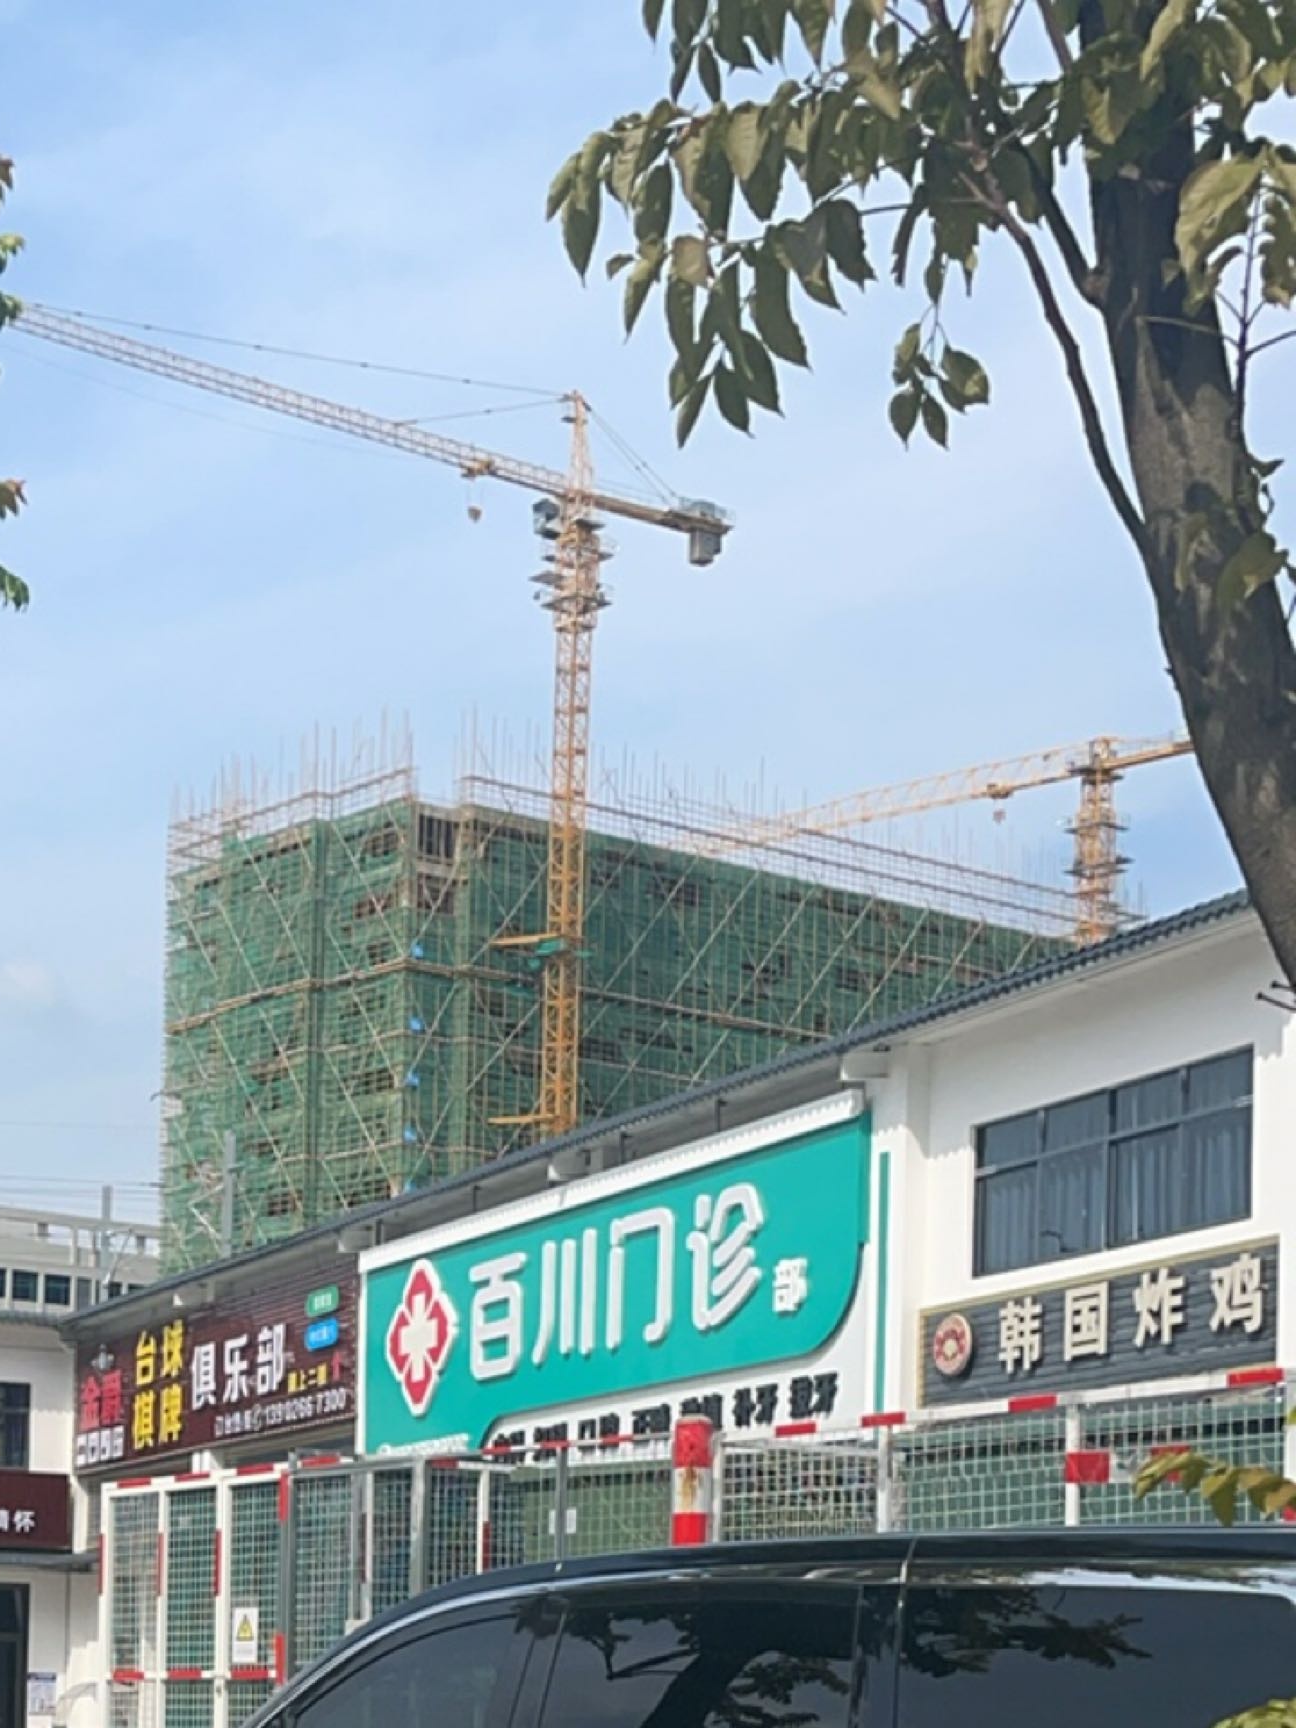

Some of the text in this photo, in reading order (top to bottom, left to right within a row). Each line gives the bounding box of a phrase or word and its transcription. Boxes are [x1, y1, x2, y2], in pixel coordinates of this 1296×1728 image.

[468, 1183, 809, 1382] 百川门诊部
[997, 1252, 1266, 1375] 韩国炸鸡
[191, 1323, 286, 1411] 俱乐部
